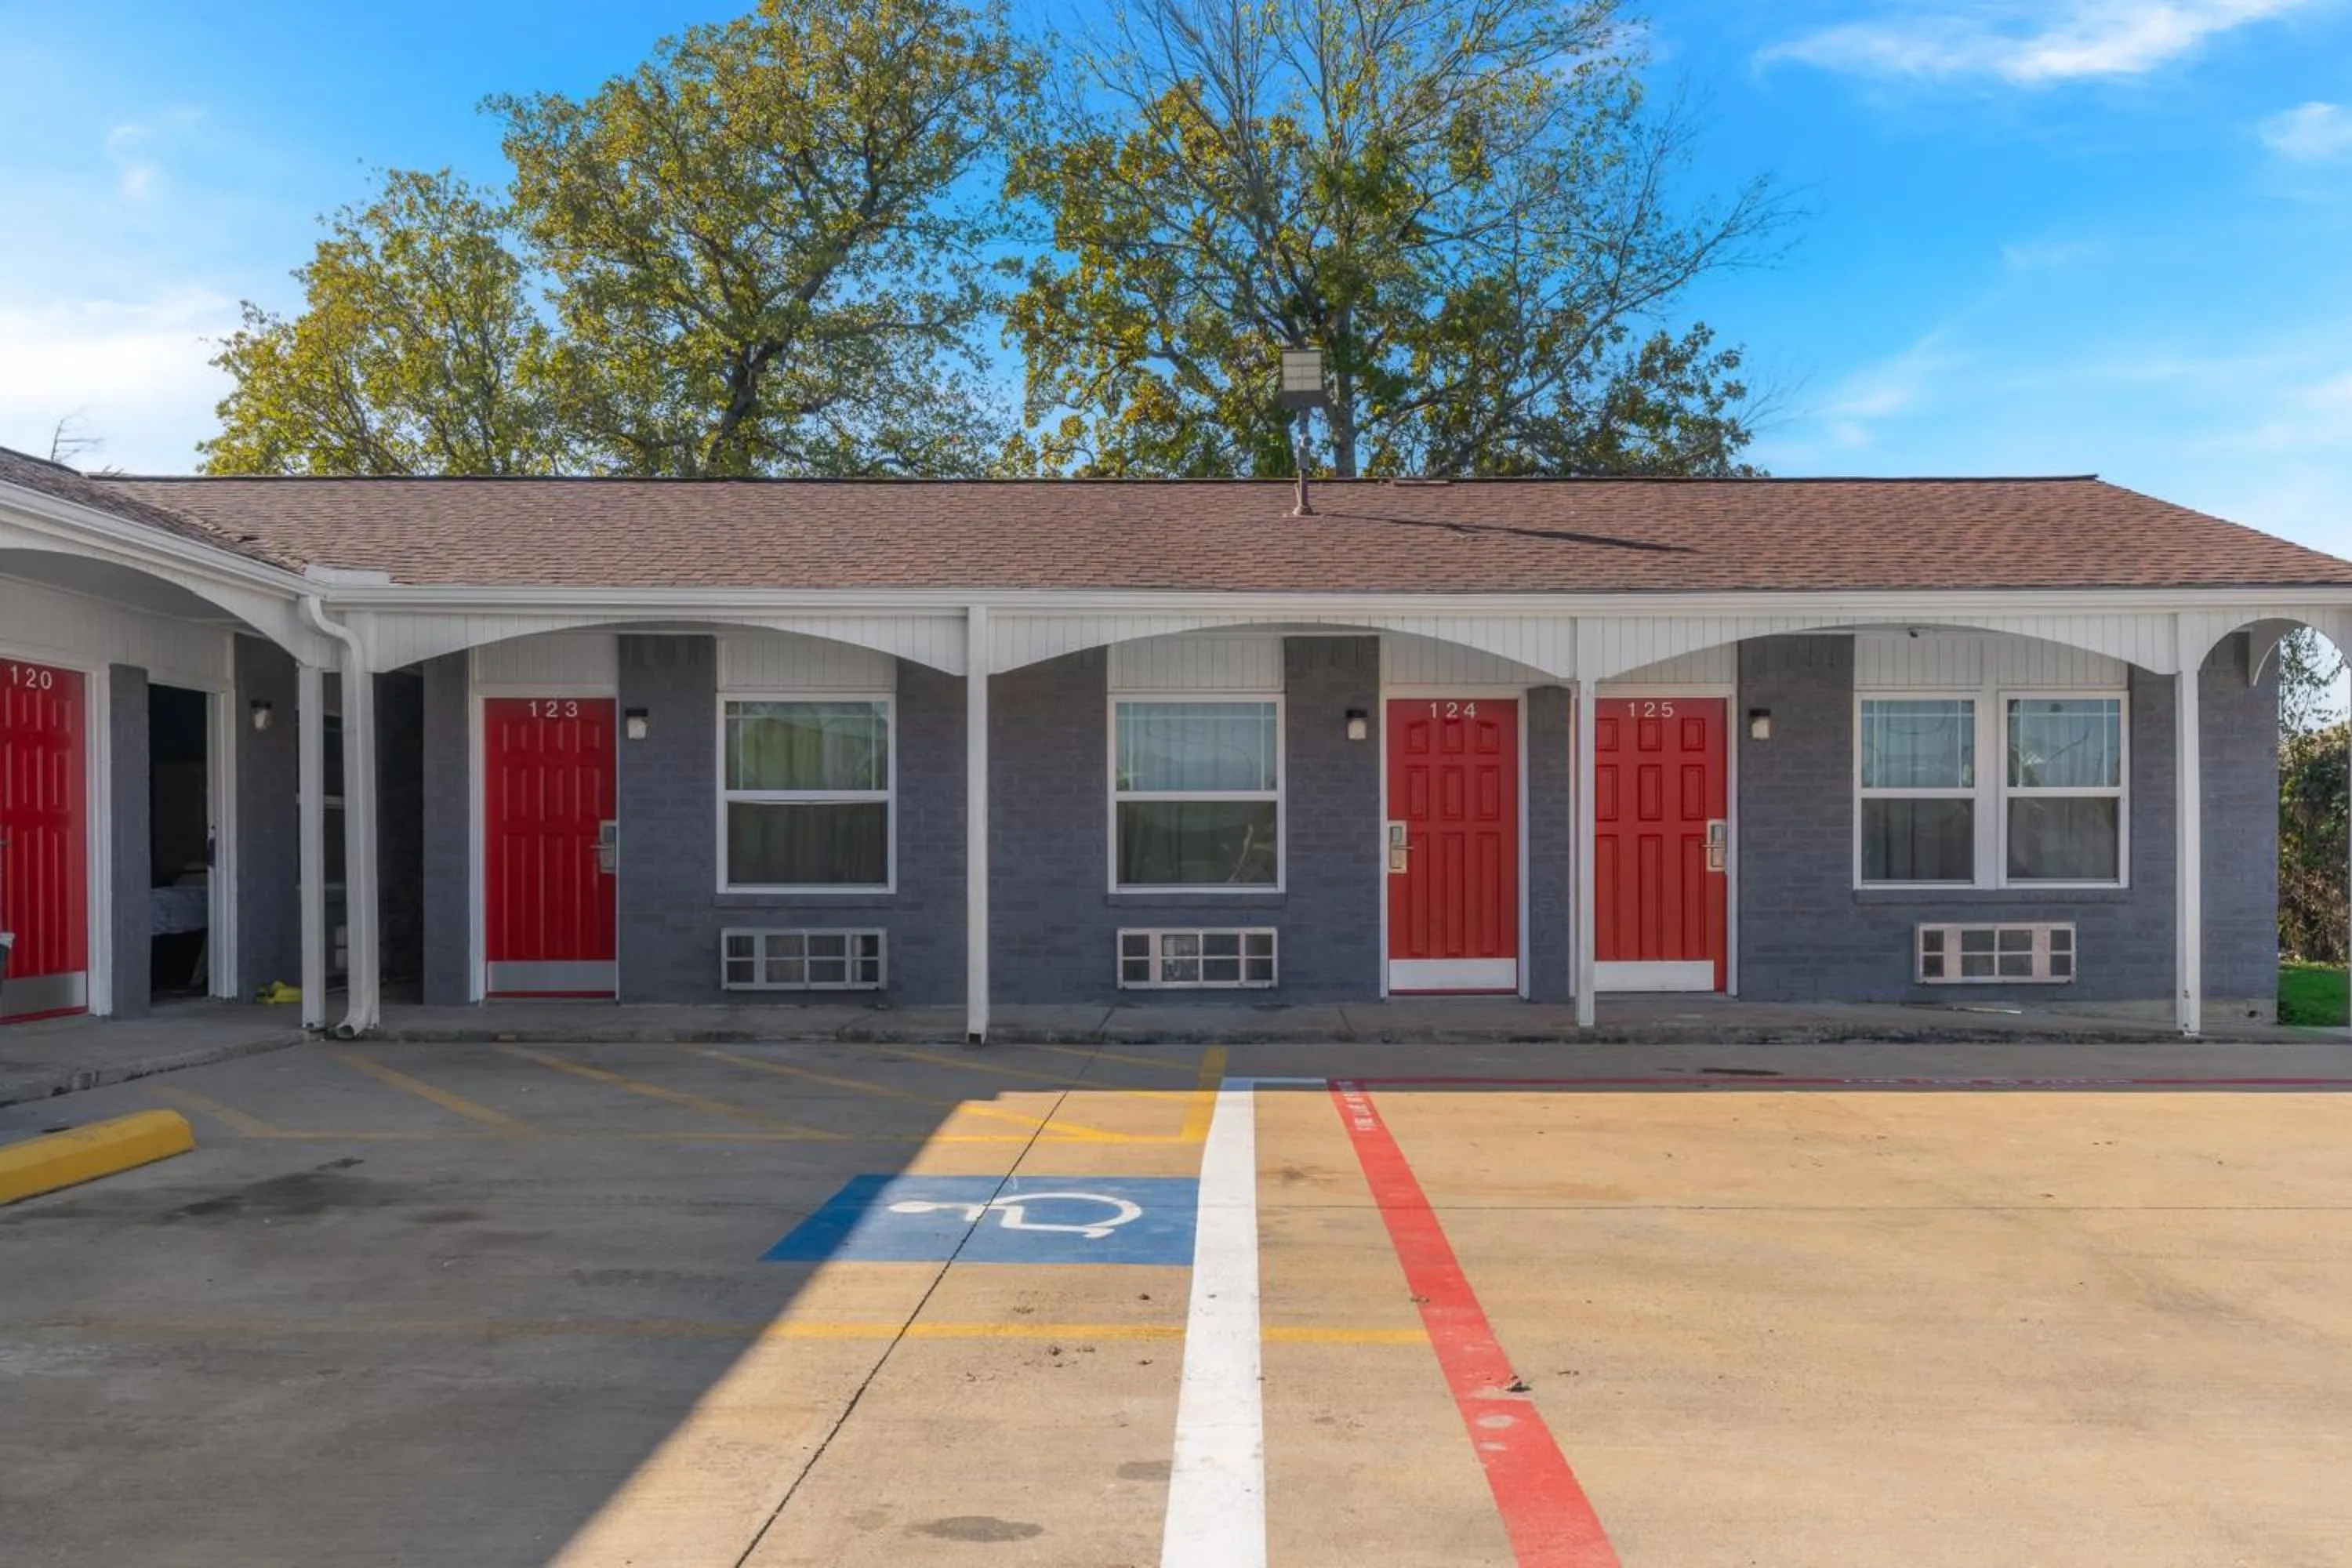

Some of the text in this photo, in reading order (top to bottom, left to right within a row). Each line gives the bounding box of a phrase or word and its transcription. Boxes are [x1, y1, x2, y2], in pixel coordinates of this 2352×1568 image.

[9, 664, 53, 690] 120
[528, 699, 579, 718] 123
[1429, 702, 1476, 720] 124
[1626, 702, 1674, 718] 125
